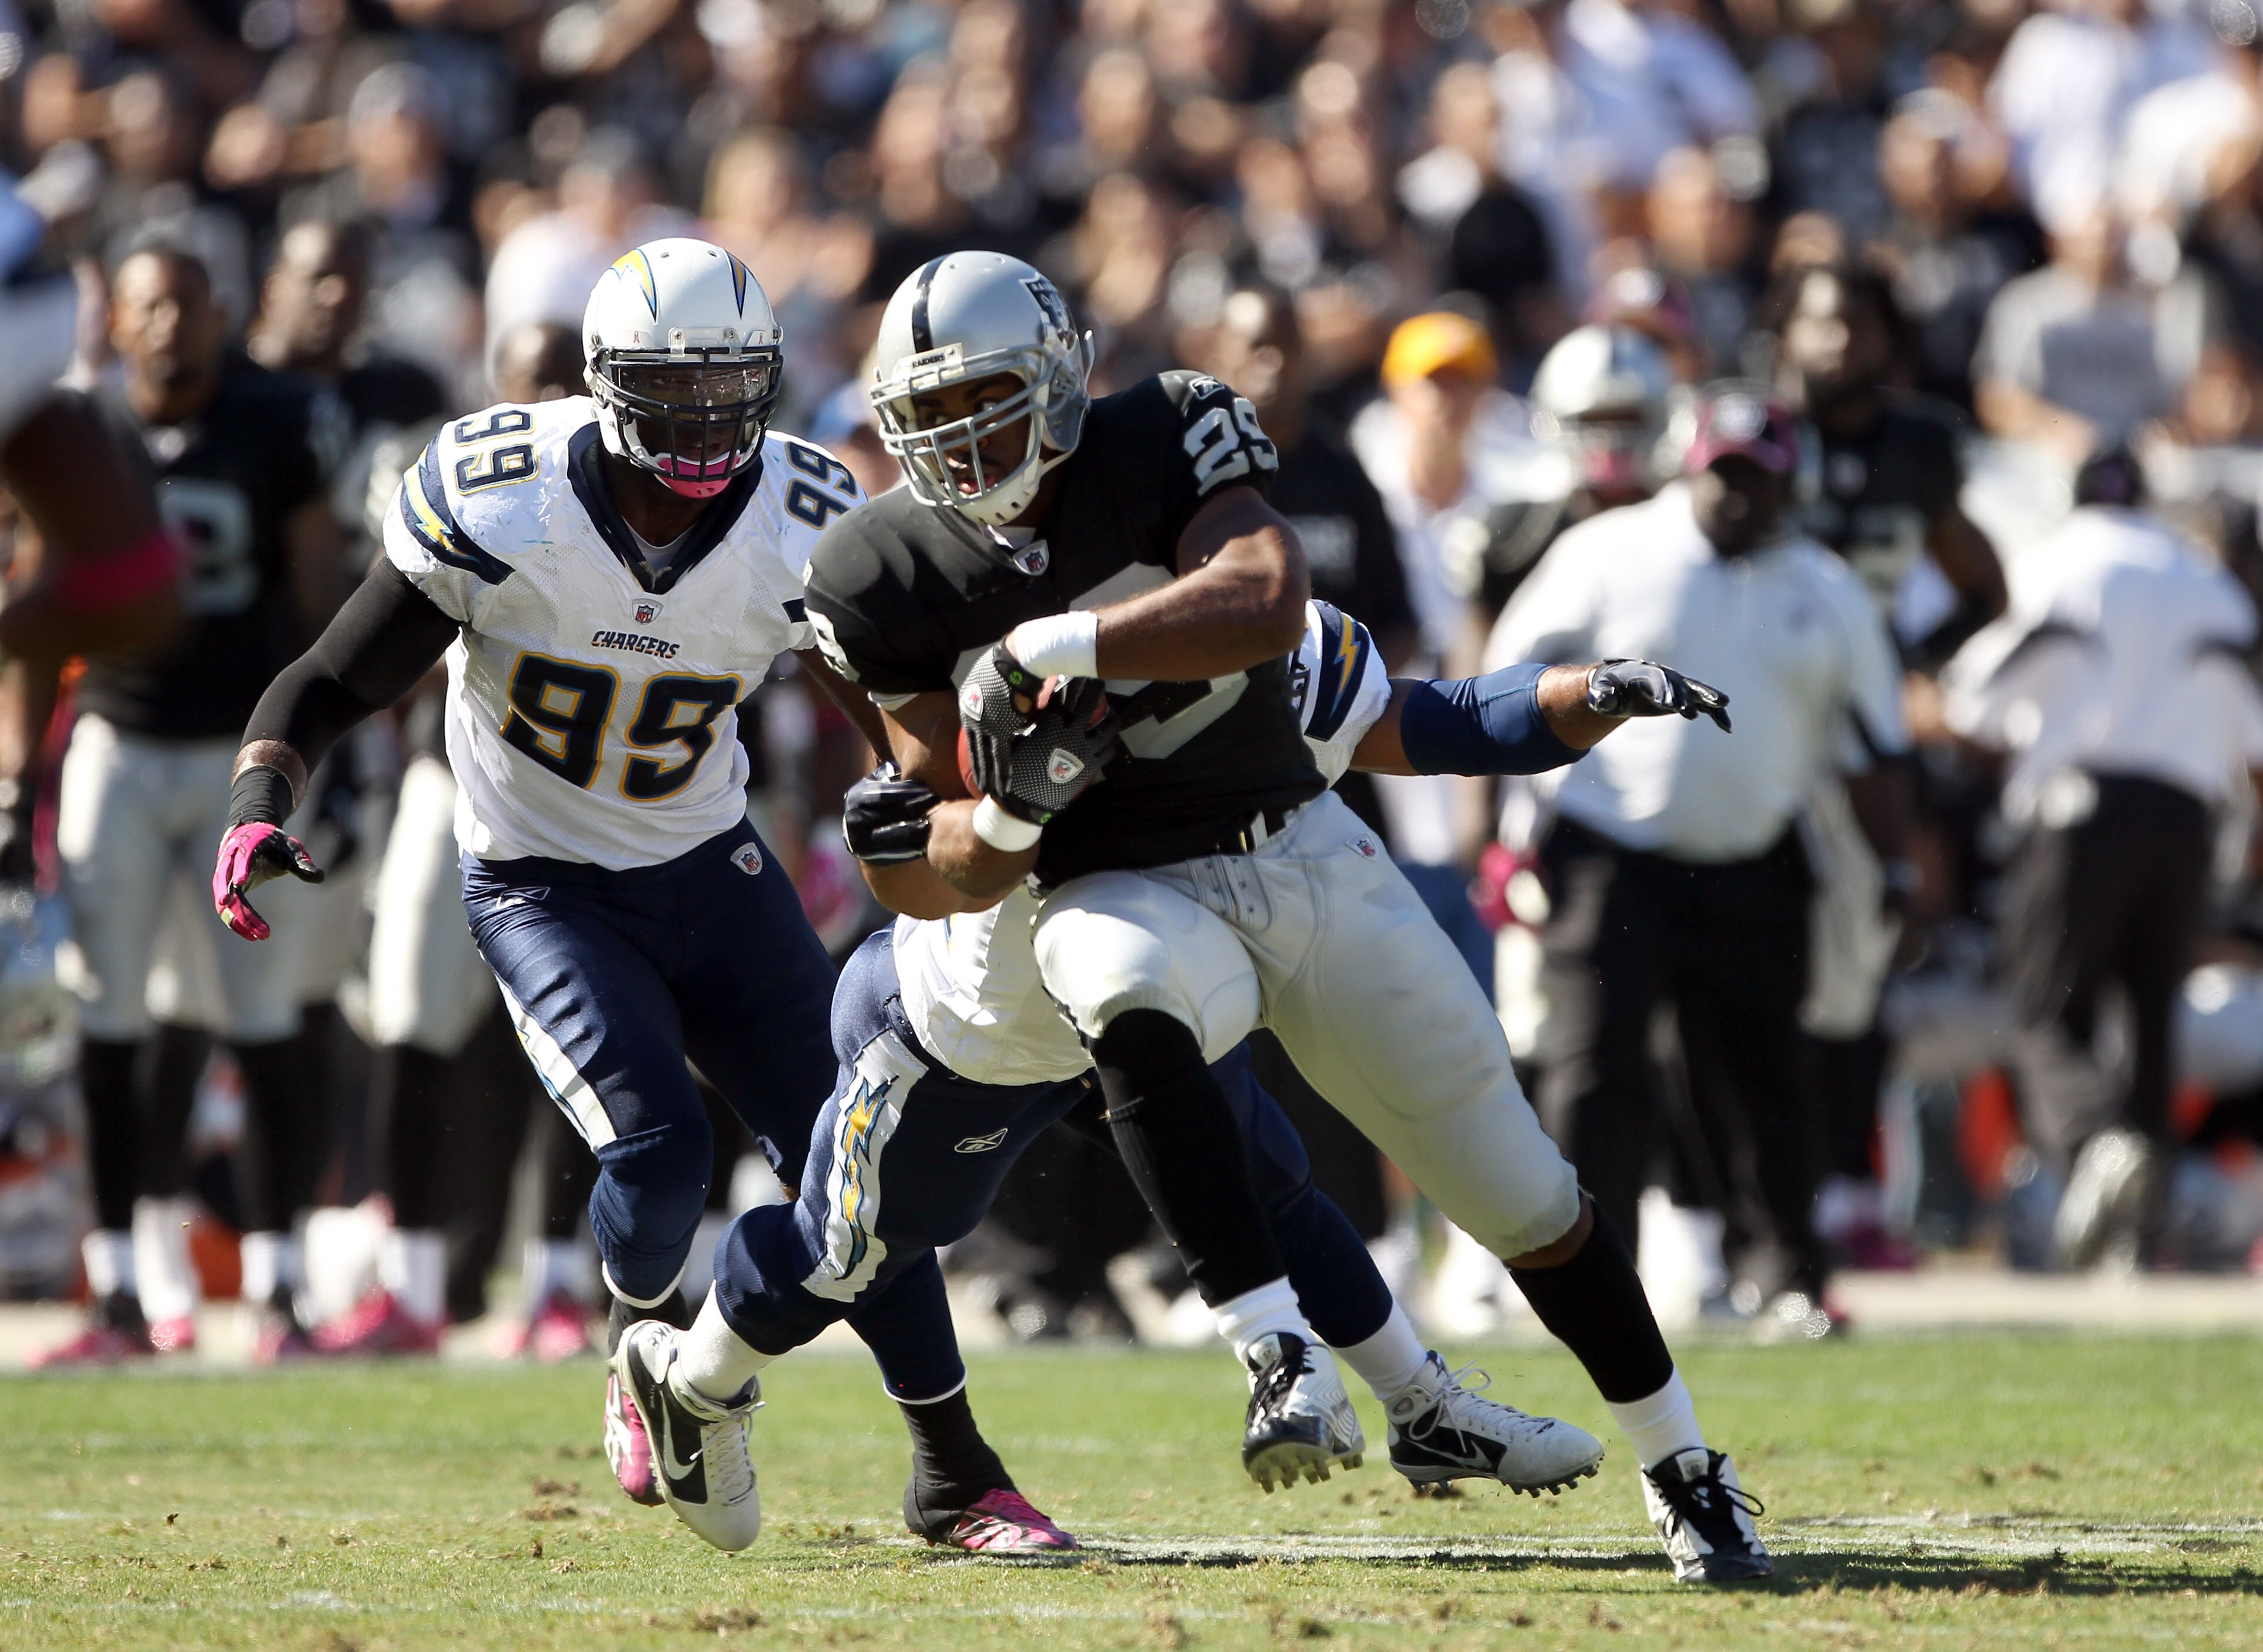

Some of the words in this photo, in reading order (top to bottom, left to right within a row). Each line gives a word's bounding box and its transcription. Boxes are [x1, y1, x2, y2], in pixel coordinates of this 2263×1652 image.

[912, 354, 946, 368] RAIDERS
[453, 410, 540, 495] 99
[784, 441, 858, 530] 99
[1184, 397, 1280, 496] 29
[591, 631, 680, 659] CHARGERS
[499, 650, 744, 802] 99
